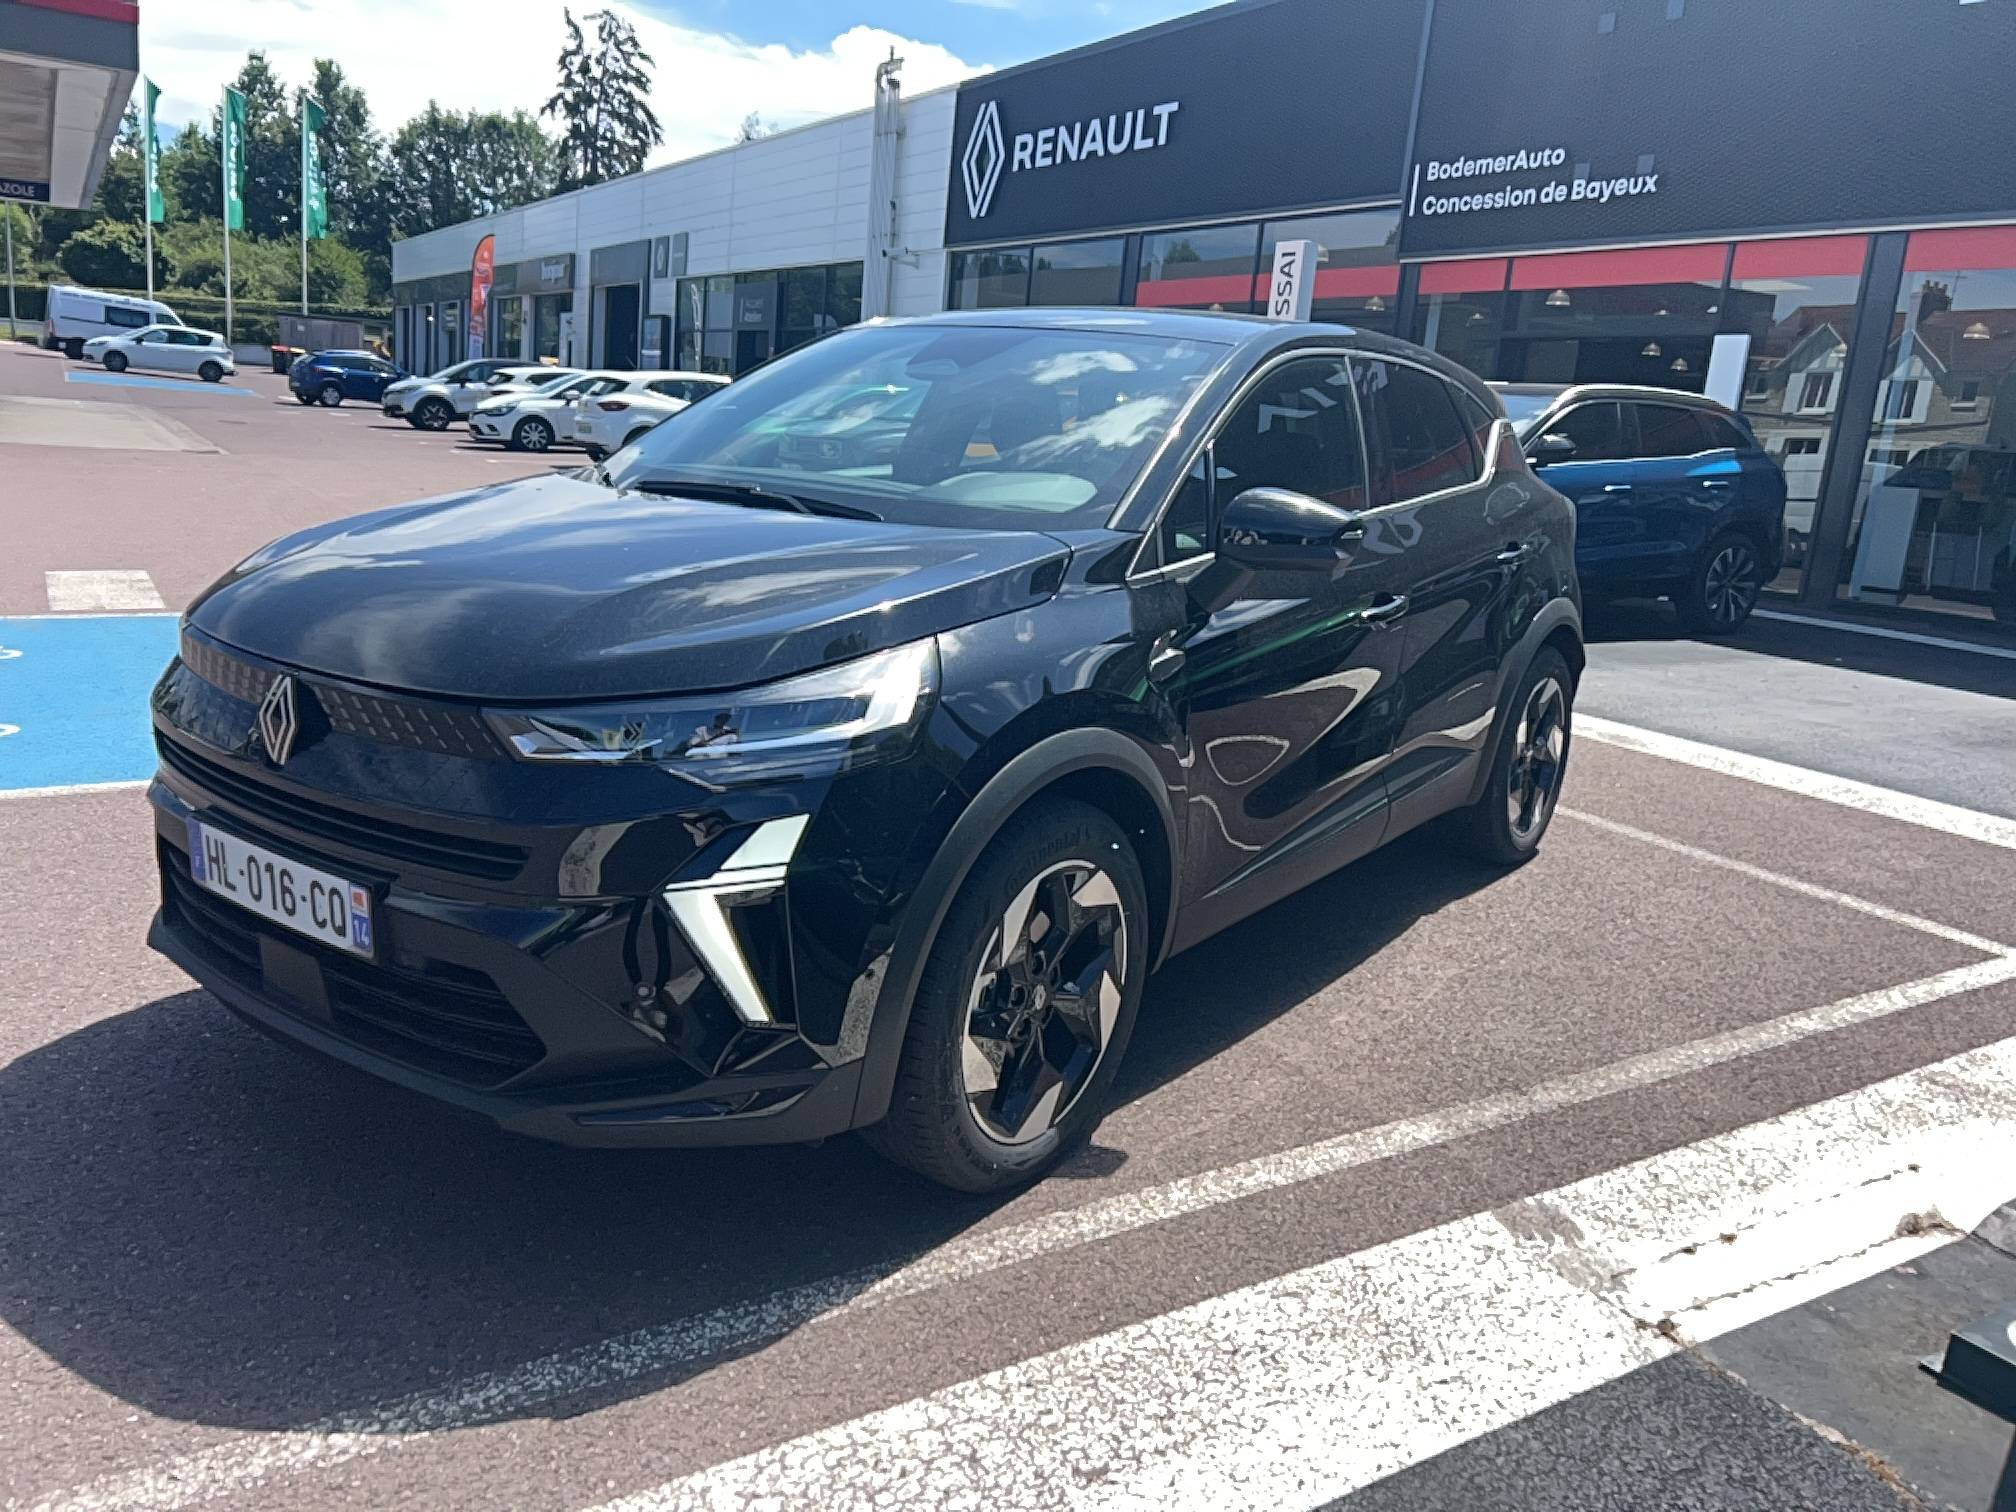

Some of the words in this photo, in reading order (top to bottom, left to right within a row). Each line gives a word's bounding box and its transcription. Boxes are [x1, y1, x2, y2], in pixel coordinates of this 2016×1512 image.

[1012, 101, 1180, 172] RENAULT
[1426, 147, 1566, 181] BodemerAuto
[1422, 185, 1536, 215] Concession
[1540, 181, 1568, 203] de
[1570, 174, 1659, 203] Bayeux
[1275, 251, 1296, 317] SSAI
[353, 919, 370, 946] 14
